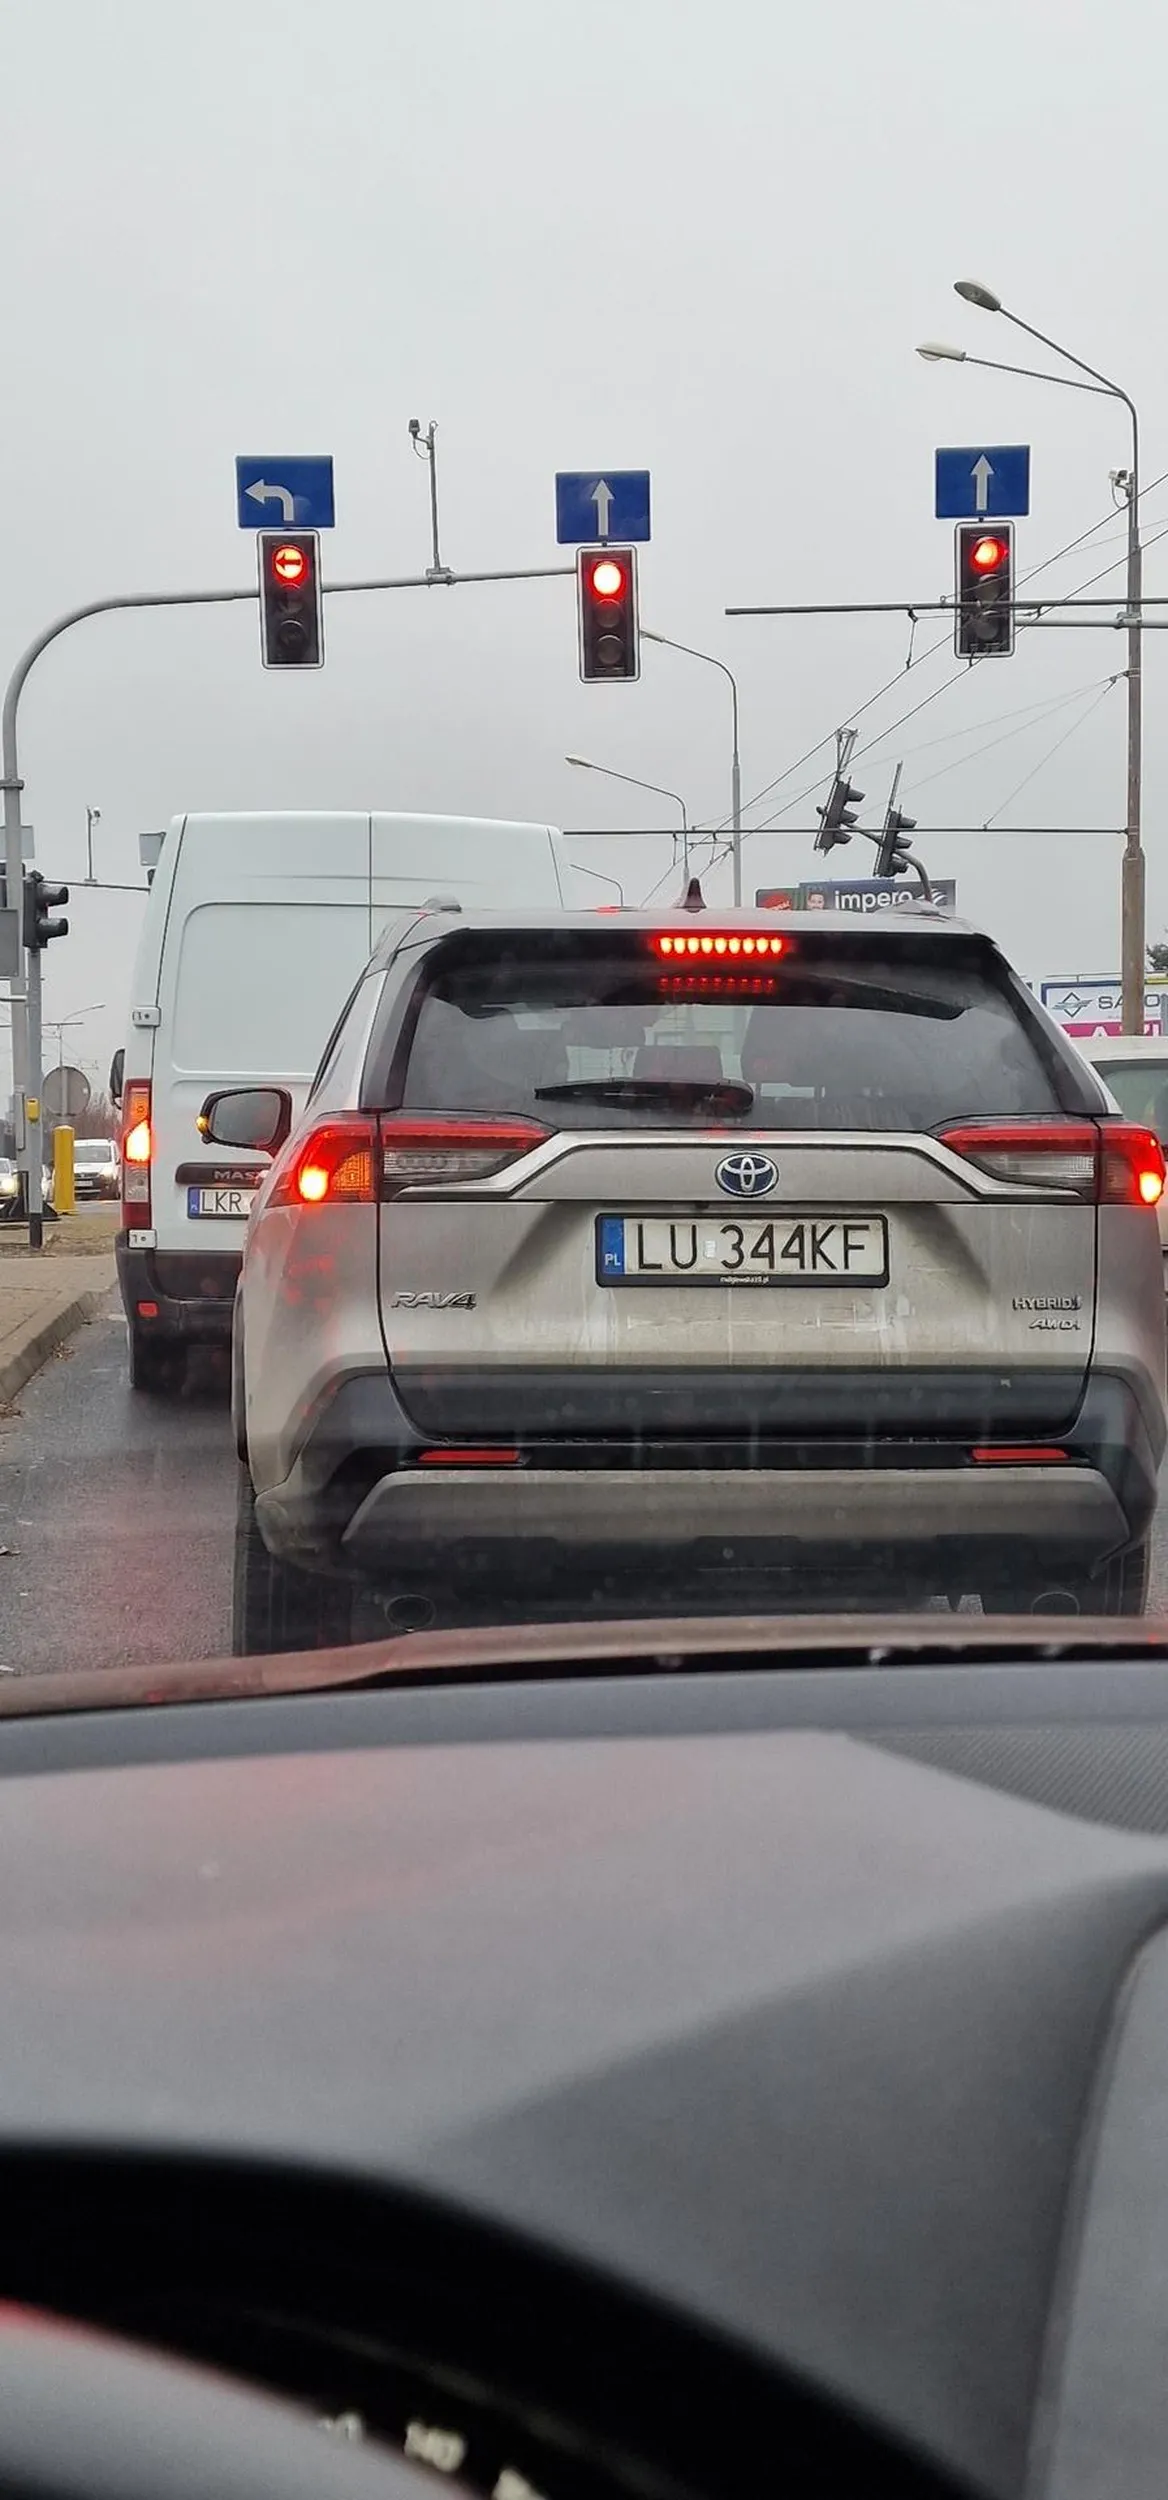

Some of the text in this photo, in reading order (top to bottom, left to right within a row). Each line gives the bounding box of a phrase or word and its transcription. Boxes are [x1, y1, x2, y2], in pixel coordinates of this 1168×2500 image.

[834, 890, 913, 912] impero
[213, 1170, 260, 1180] MAS
[202, 1191, 242, 1212] LKR
[637, 1224, 870, 1270] LU 344KF
[604, 1253, 622, 1266] PL
[391, 1291, 477, 1309] RAV4
[1012, 1297, 1073, 1310] HYBRID
